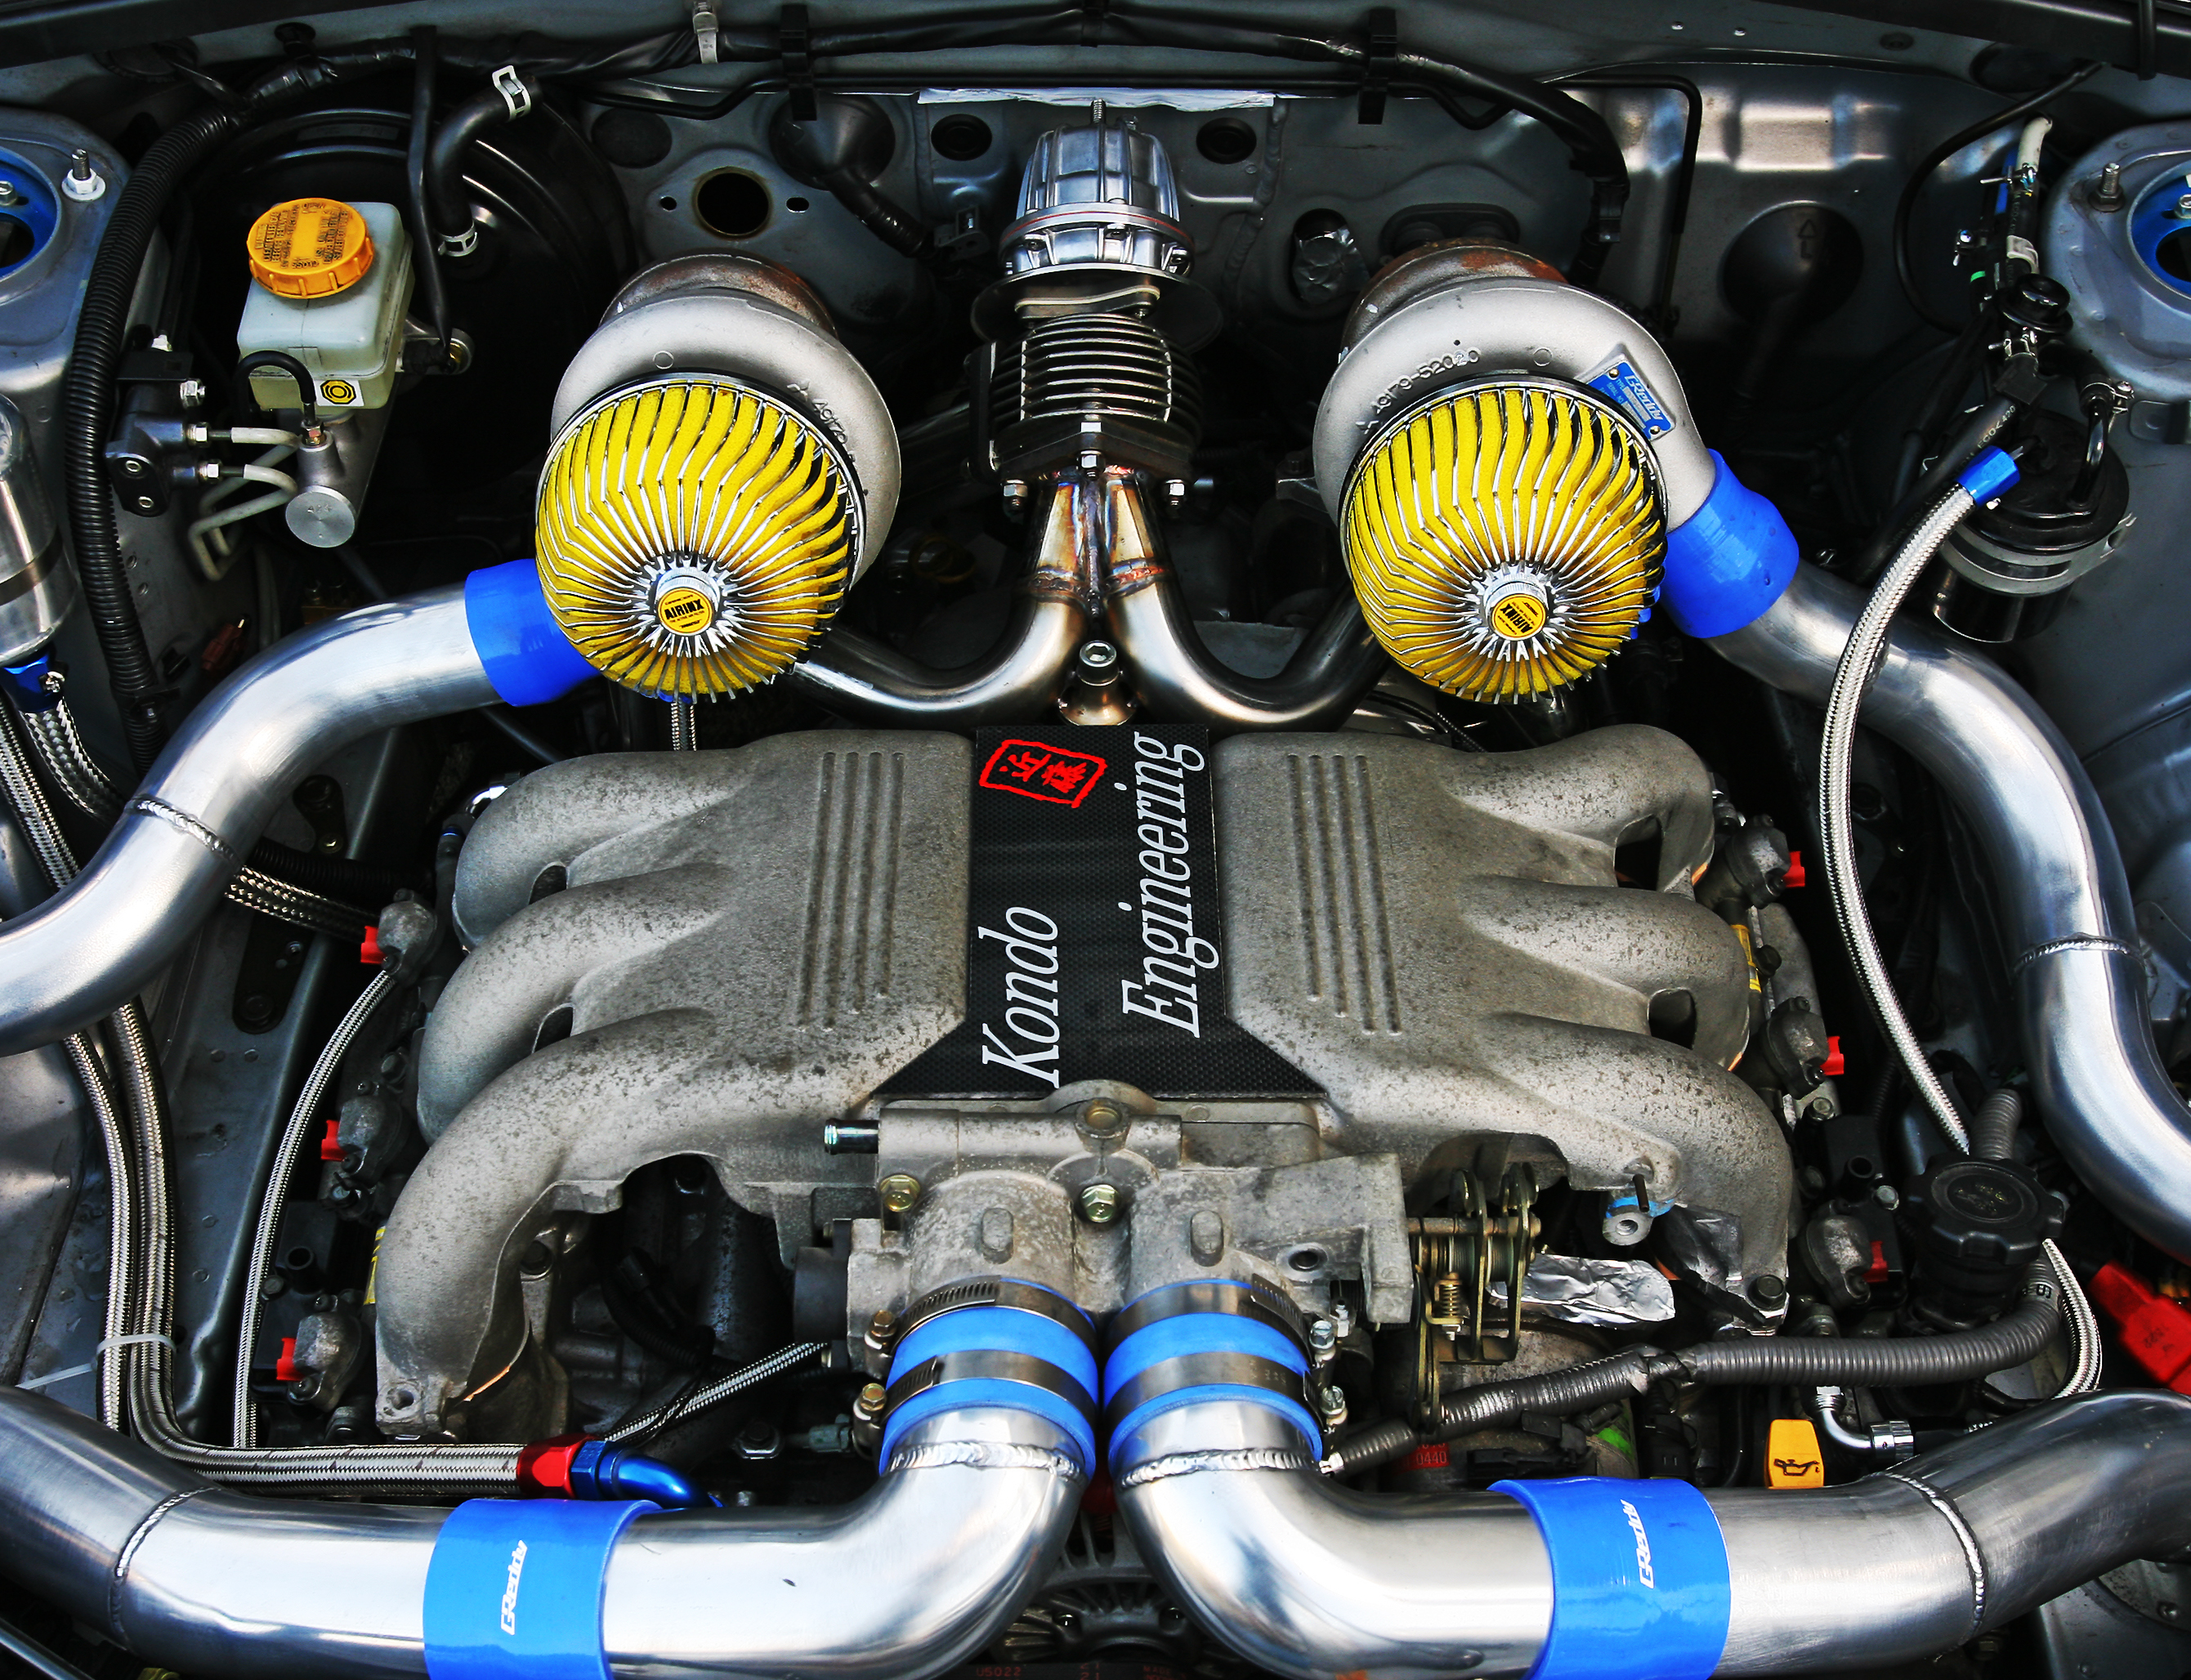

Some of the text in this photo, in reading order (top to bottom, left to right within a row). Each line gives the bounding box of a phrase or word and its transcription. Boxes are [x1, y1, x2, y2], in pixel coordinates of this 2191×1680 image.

[664, 599, 704, 619] AIRINX
[1500, 603, 1533, 633] AIRINX
[1114, 731, 1219, 1039] Engineering
[977, 906, 1060, 1089] Kondo
[500, 1539, 528, 1635] GReddy
[1620, 1499, 1654, 1589] GReddy
